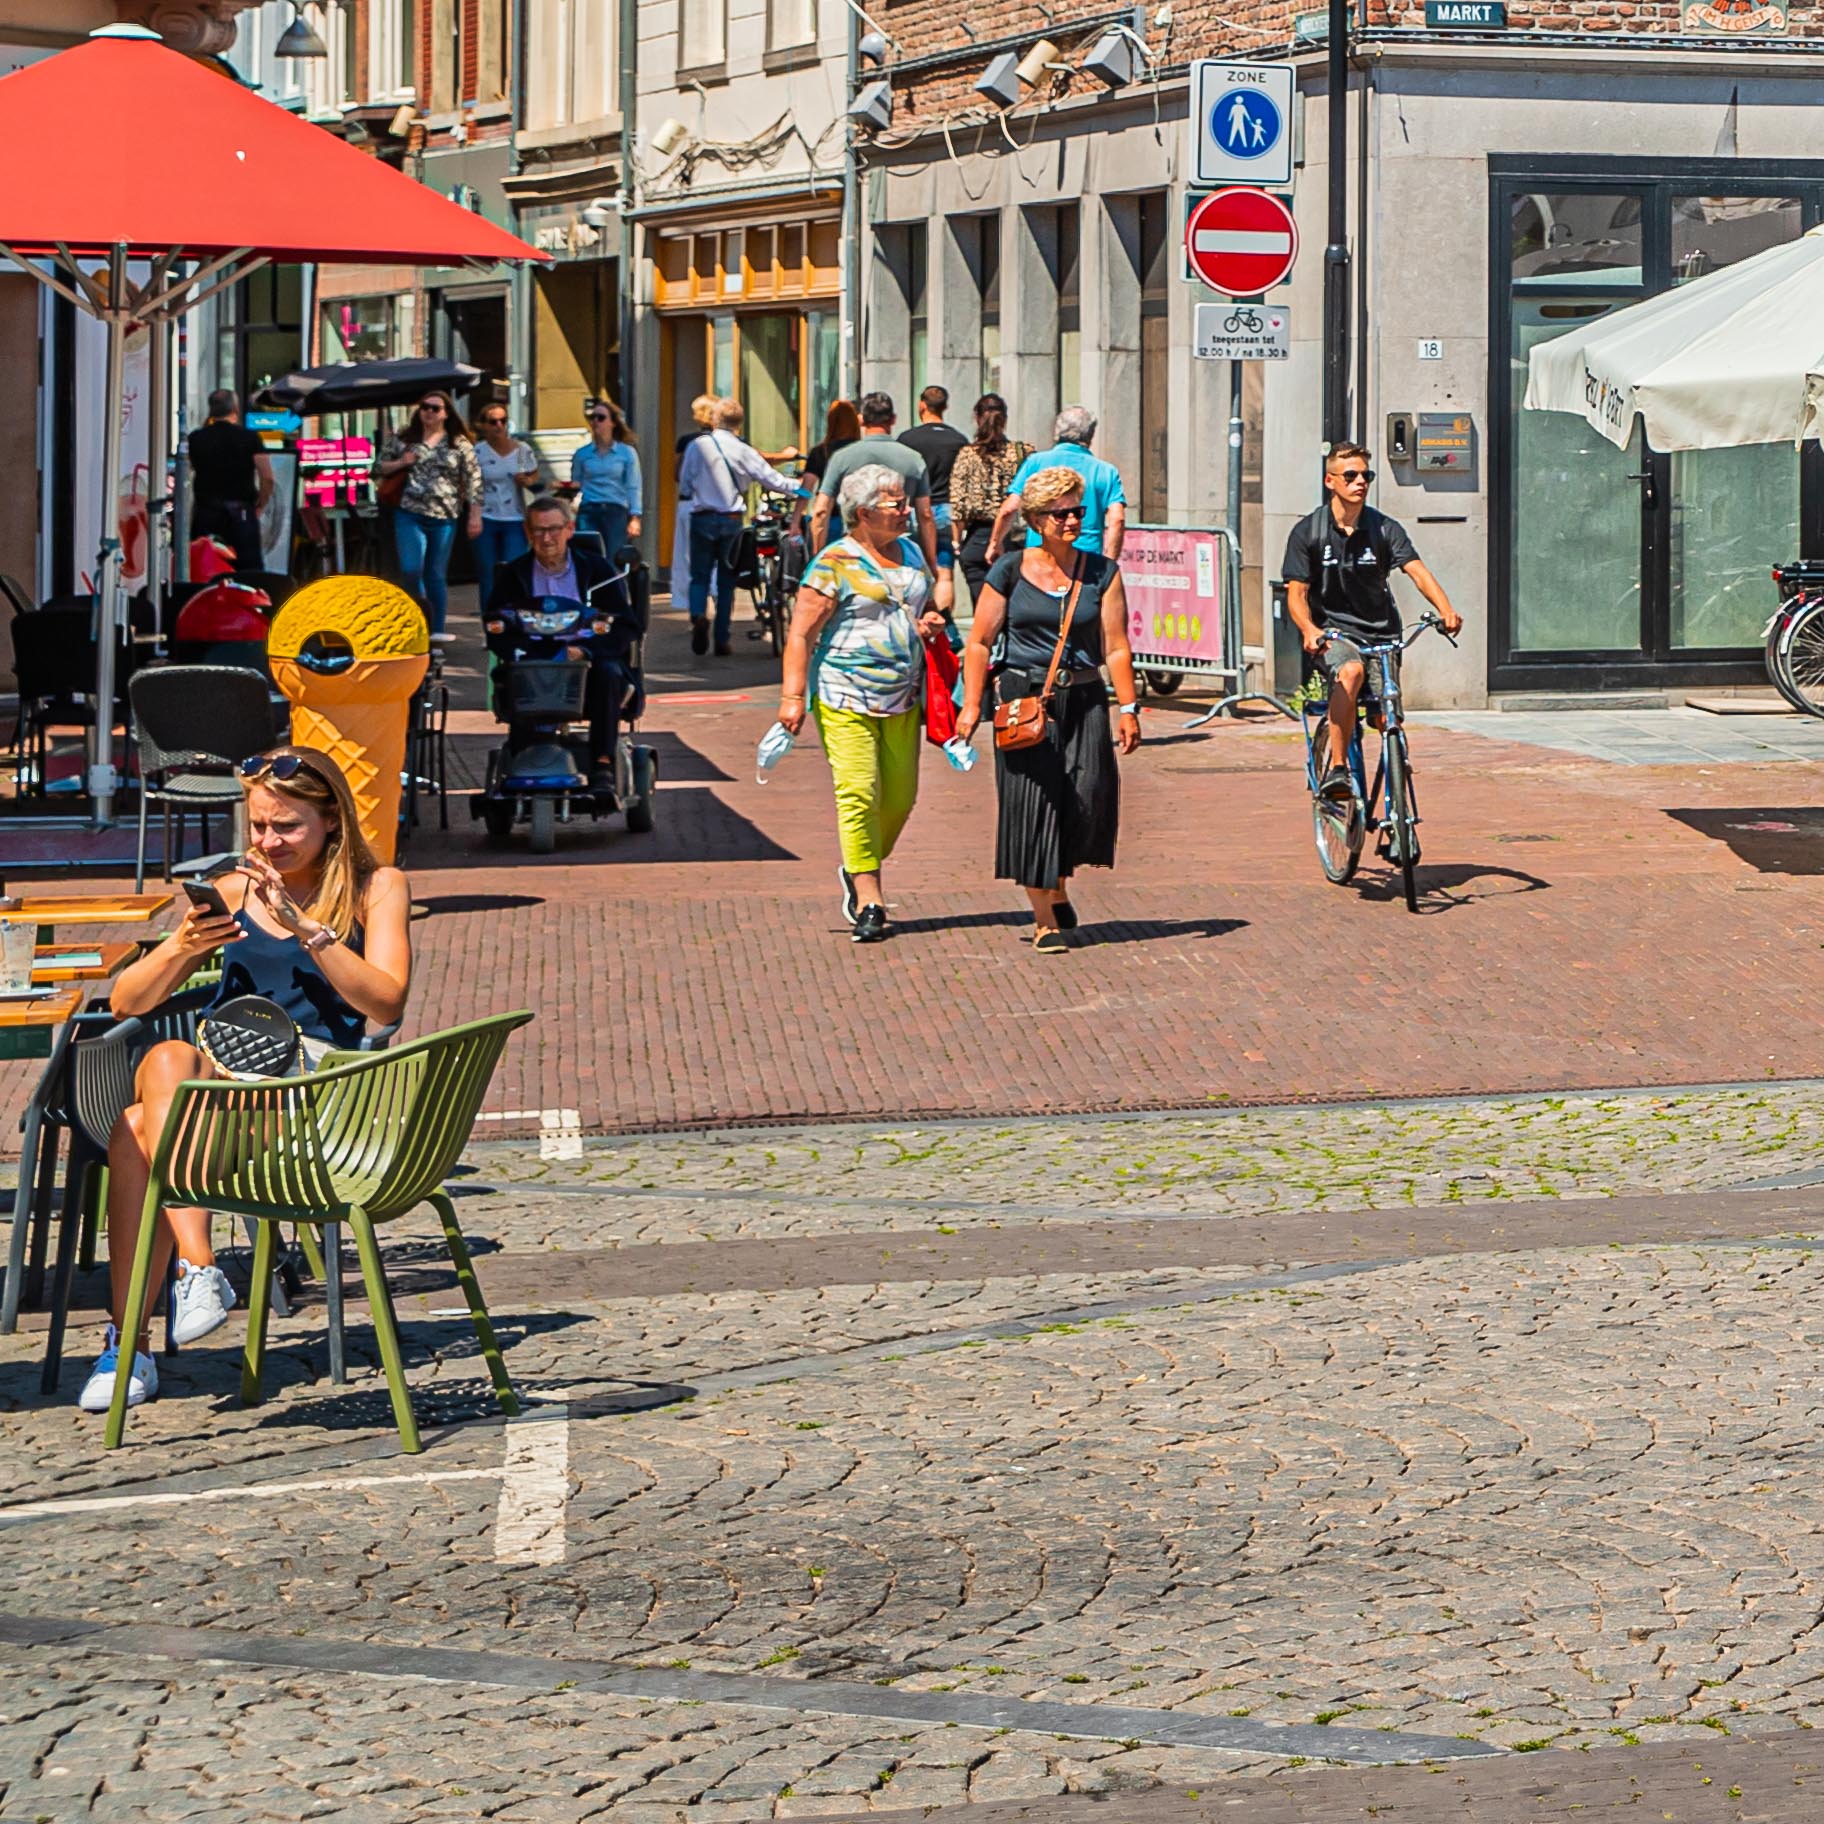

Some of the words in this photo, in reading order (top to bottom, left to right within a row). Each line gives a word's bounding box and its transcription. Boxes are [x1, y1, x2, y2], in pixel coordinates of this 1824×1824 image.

[1437, 5, 1492, 21] MARKT
[1227, 70, 1267, 83] ZONE
[1212, 335, 1260, 346] toegestaan
[1262, 336, 1275, 344] tot
[1424, 342, 1438, 356] 18
